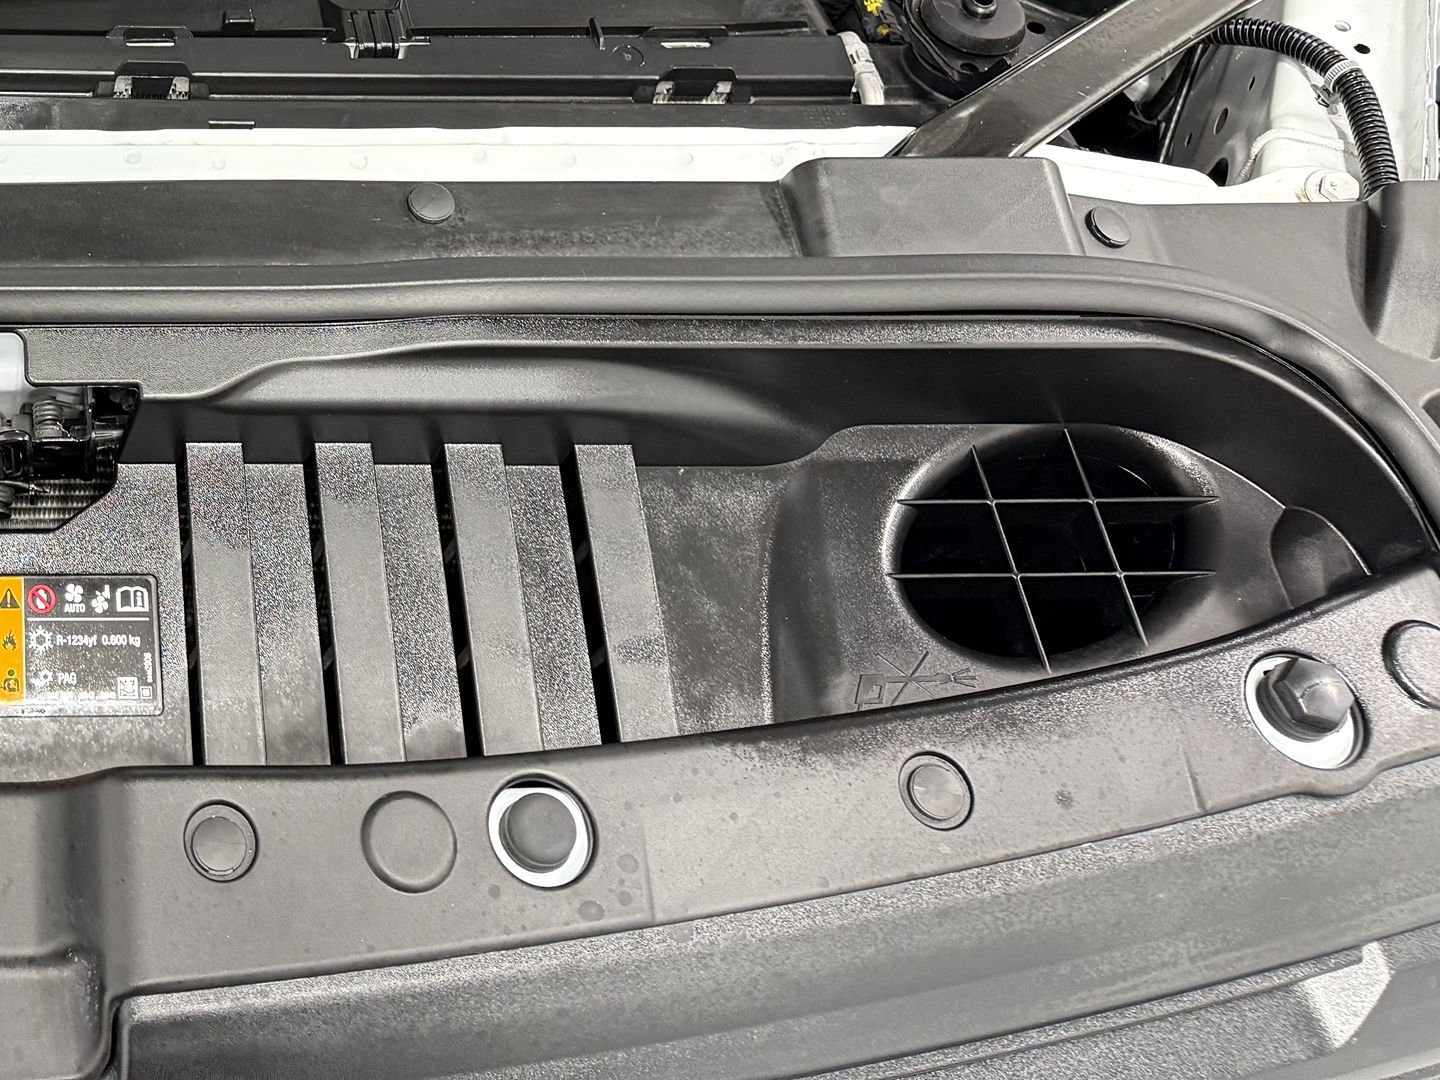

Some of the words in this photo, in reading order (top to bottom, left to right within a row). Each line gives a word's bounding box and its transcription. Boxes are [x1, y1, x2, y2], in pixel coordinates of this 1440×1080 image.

[63, 603, 86, 613] AUTO
[56, 634, 98, 648] R-1234yf
[101, 634, 127, 646] 0.600
[129, 634, 141, 648] kg
[57, 672, 77, 684] PAG
